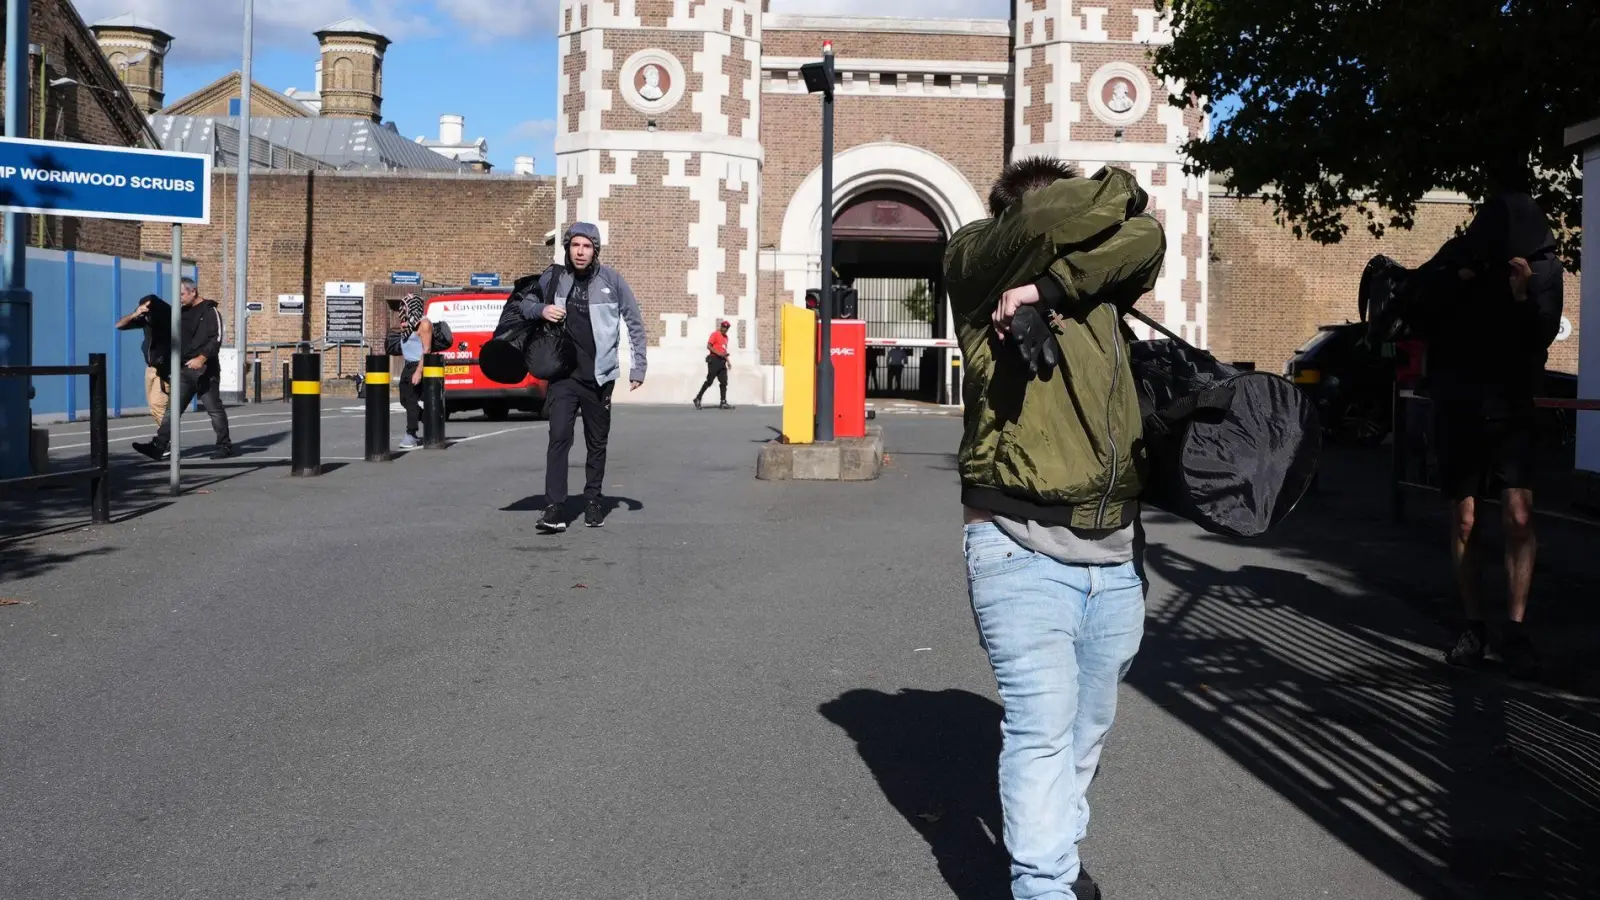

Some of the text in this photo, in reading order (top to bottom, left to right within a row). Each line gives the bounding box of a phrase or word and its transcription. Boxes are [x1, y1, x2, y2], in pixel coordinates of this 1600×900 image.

[20, 167, 126, 187] WORMWOOD
[130, 176, 195, 192] SCRUBS
[452, 302, 503, 311] Ravenston
[439, 352, 456, 360] 700
